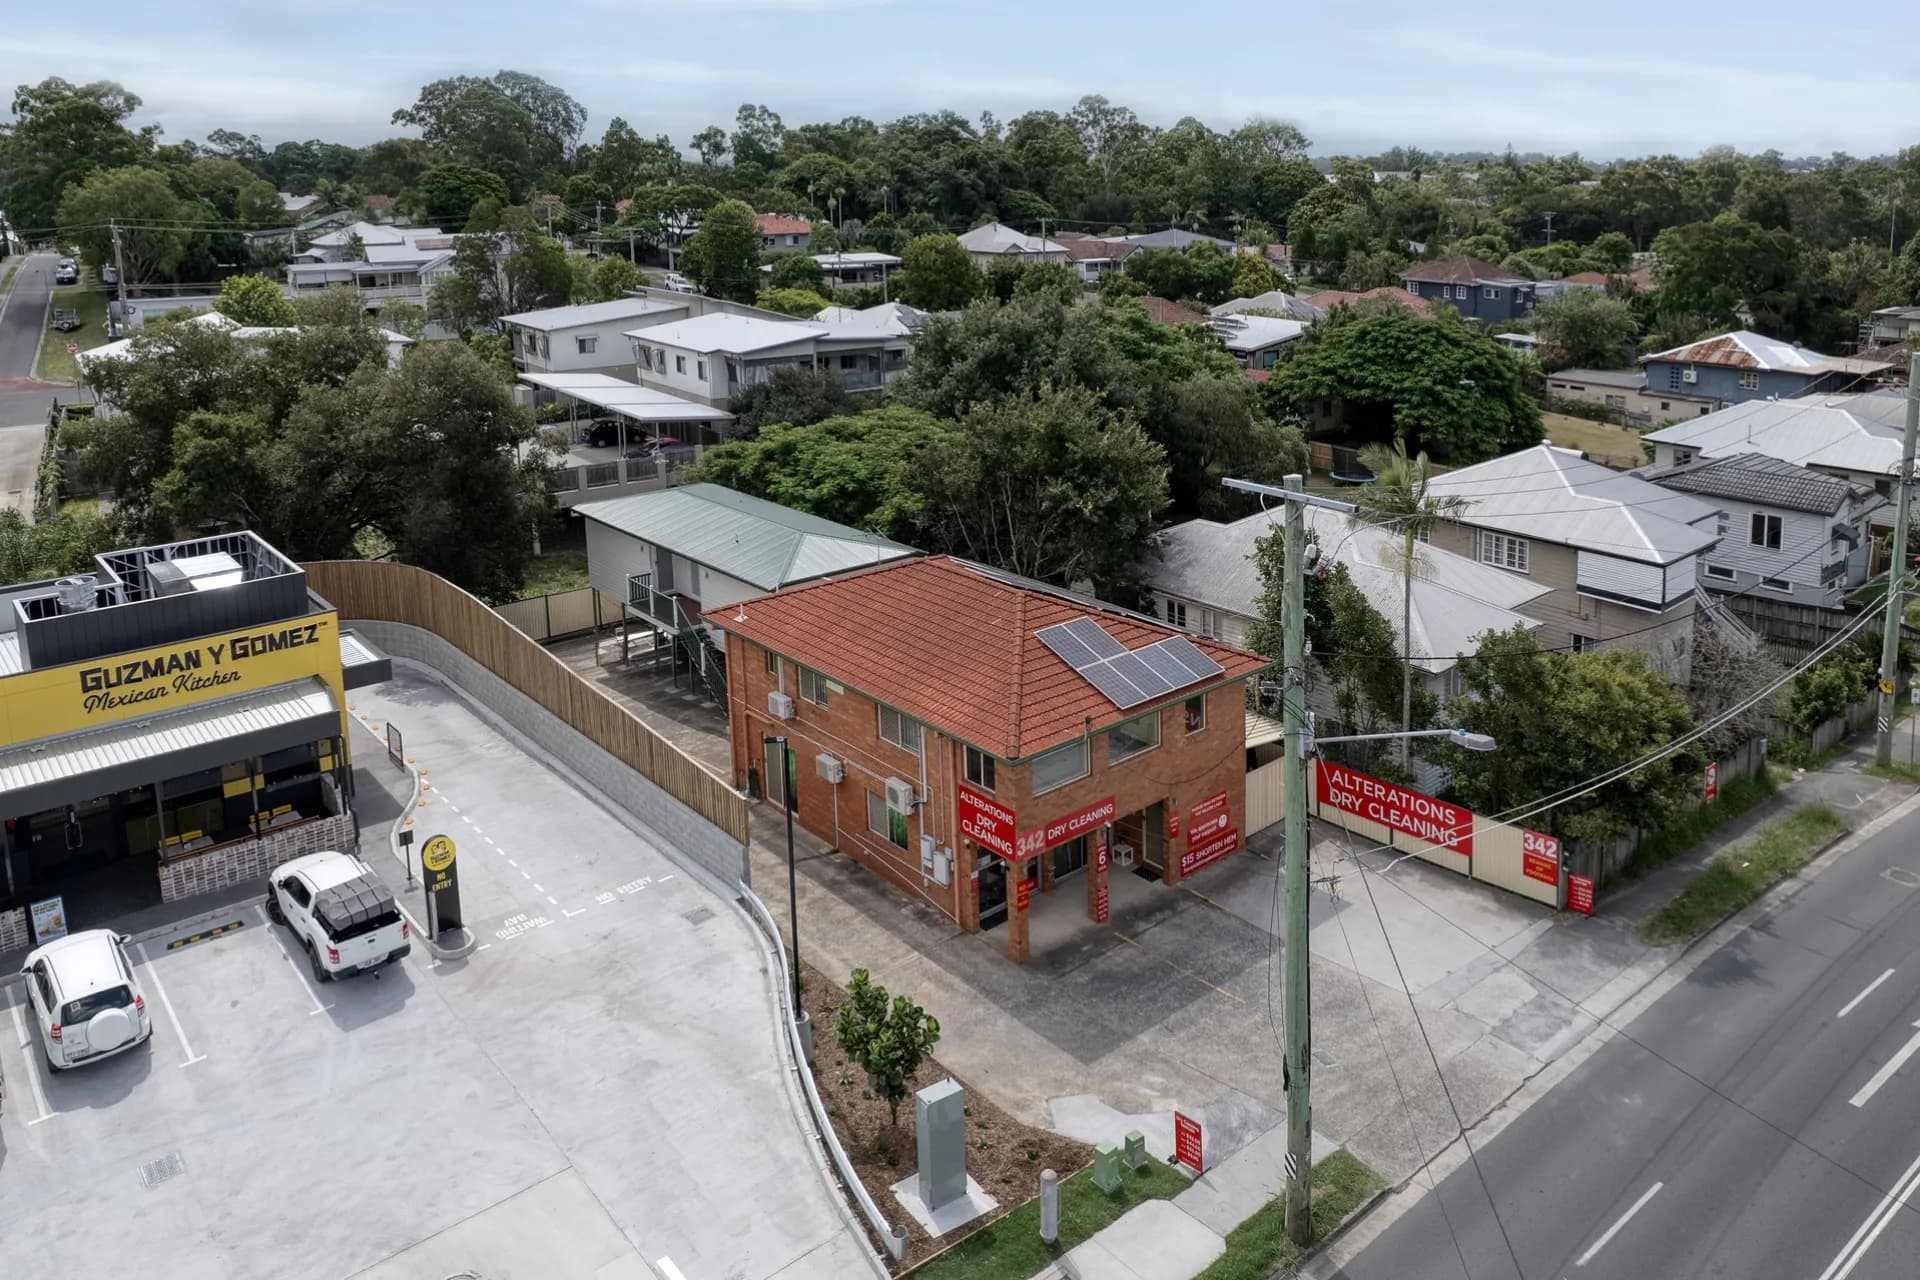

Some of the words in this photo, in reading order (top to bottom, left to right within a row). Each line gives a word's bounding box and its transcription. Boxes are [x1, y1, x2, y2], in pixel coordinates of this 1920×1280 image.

[79, 649, 202, 694] GUZMAN
[207, 643, 225, 665] Y
[83, 686, 169, 714] Mexican
[173, 670, 242, 694] Kitchen
[960, 791, 1014, 826] ALTERATIONS
[1329, 788, 1363, 811] DRY
[1368, 803, 1458, 846] CLEANING
[1331, 769, 1456, 825] ALTERATIONS
[962, 819, 1013, 855] CLEANING
[976, 813, 997, 832] DRY
[1017, 830, 1044, 857] 342
[1048, 826, 1067, 840] DRY
[1069, 803, 1113, 830] CLEANING
[1098, 851, 1106, 864] 6
[1524, 833, 1557, 859] 342
